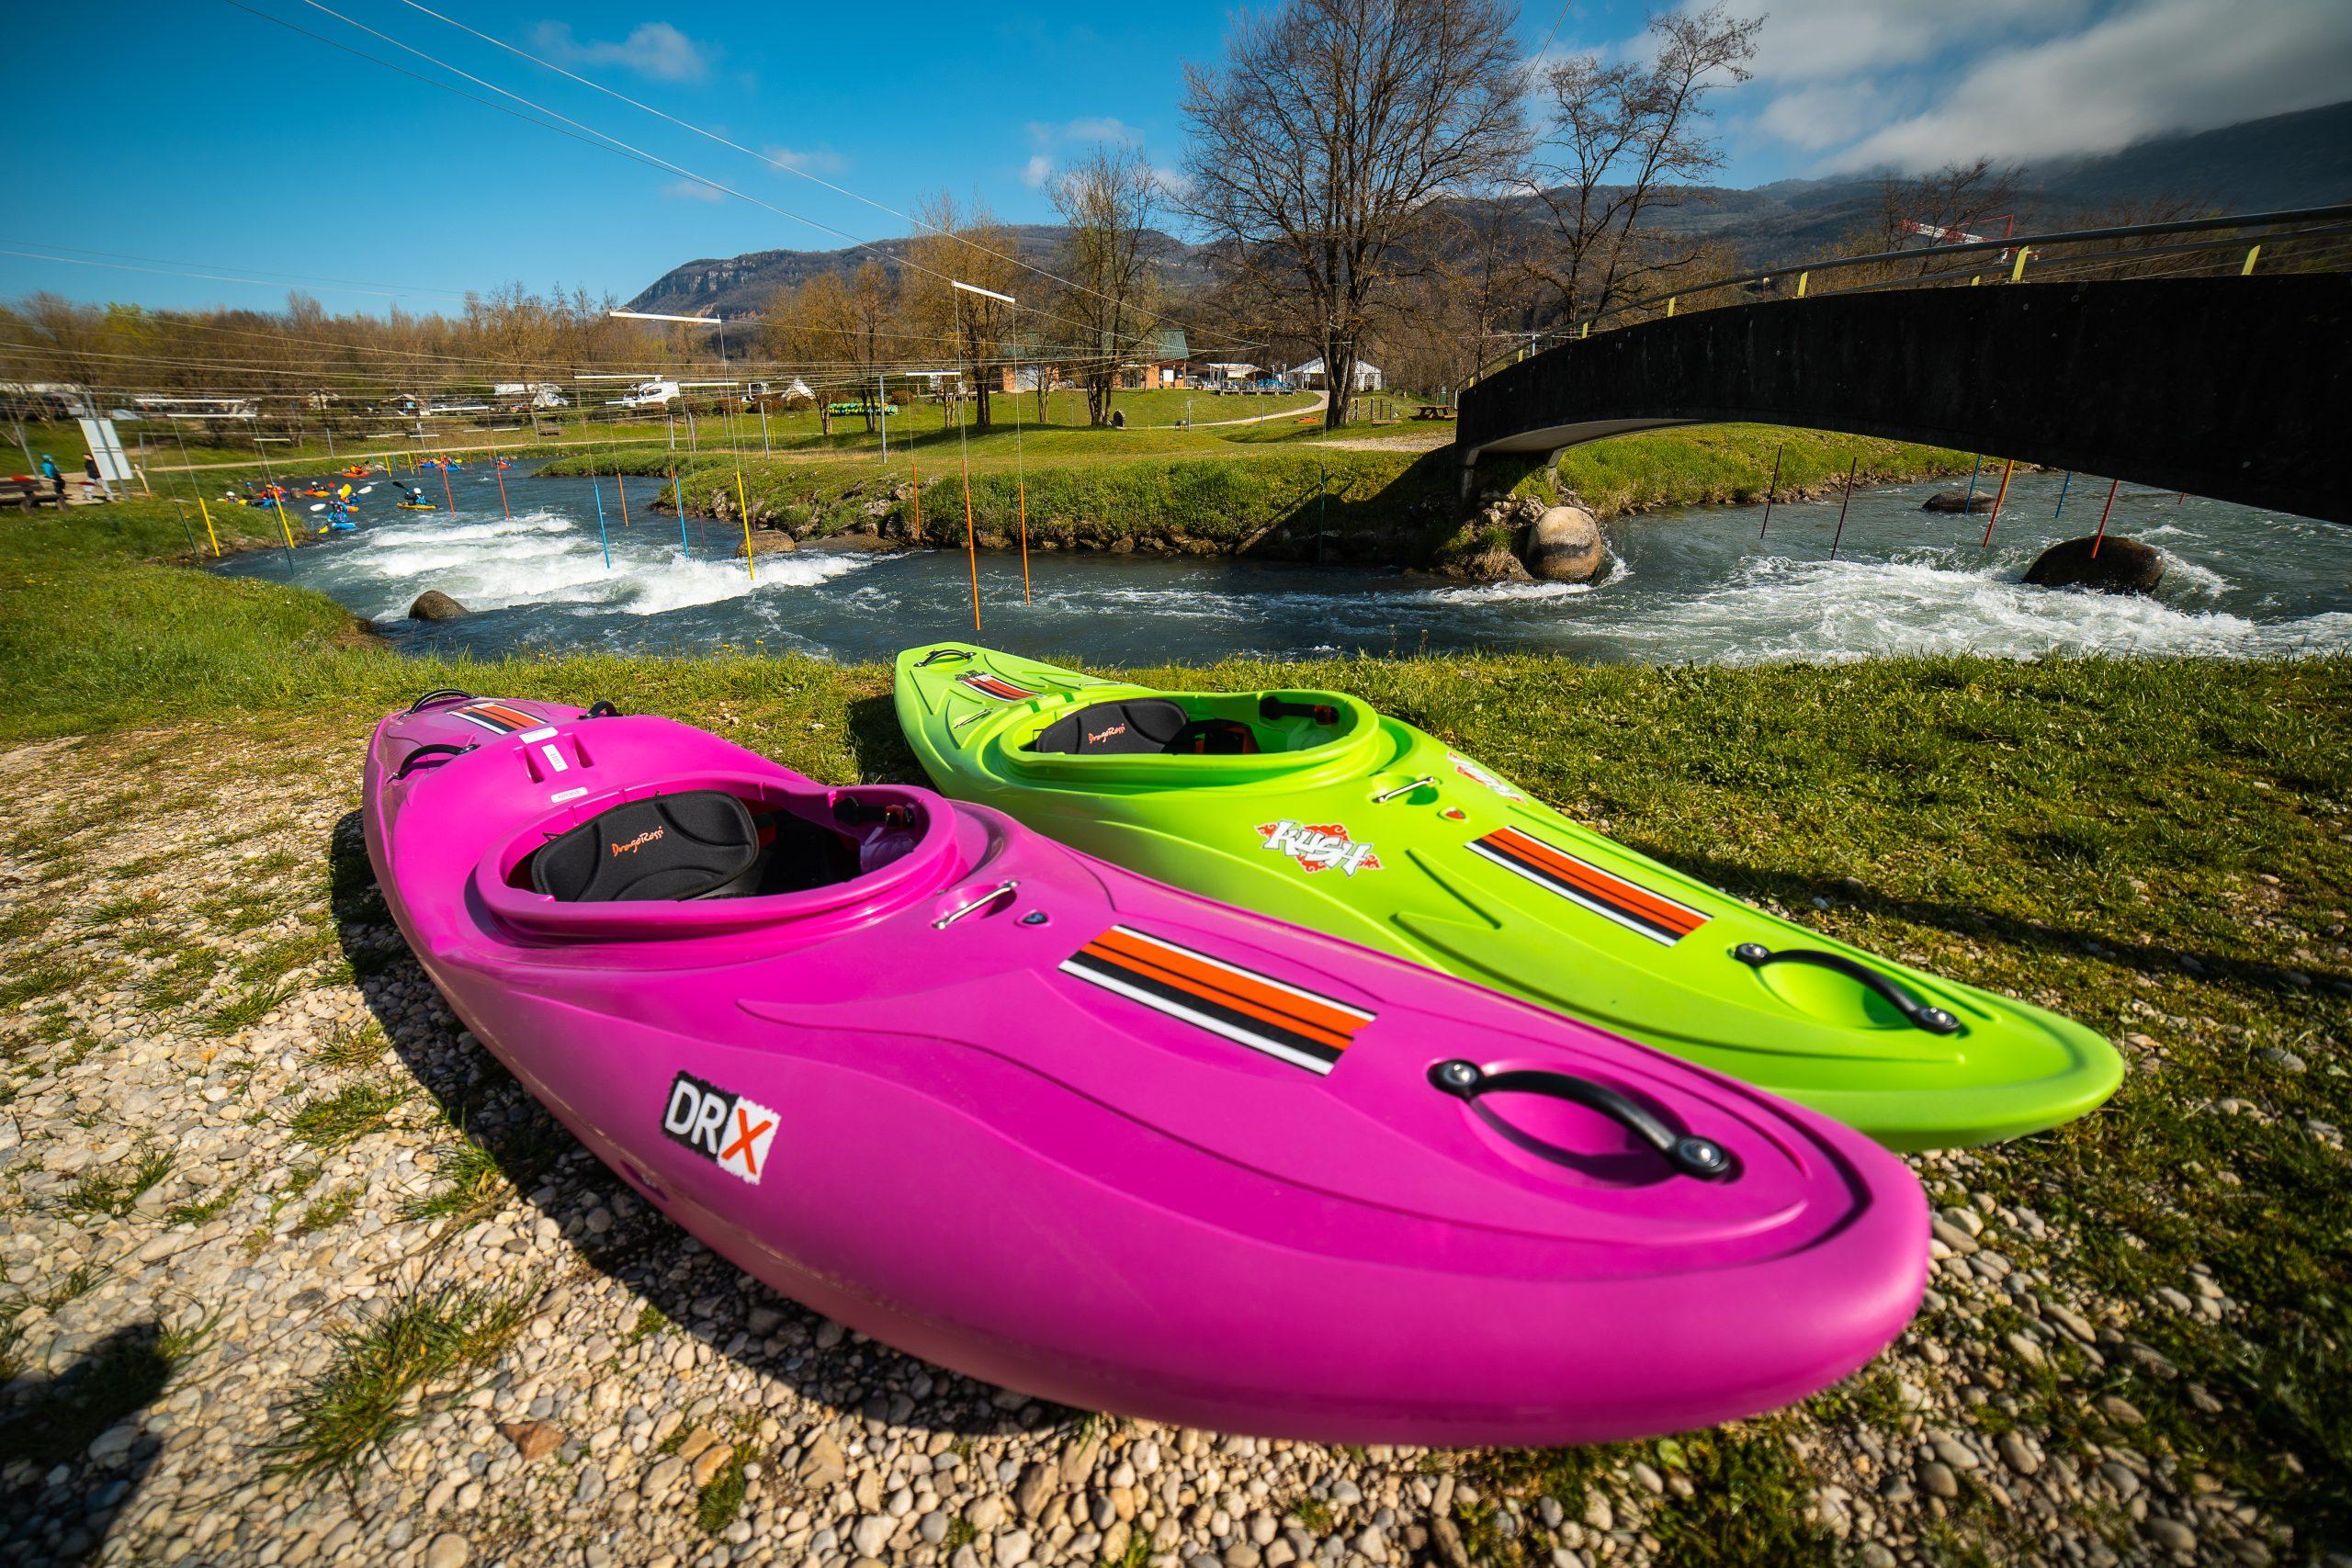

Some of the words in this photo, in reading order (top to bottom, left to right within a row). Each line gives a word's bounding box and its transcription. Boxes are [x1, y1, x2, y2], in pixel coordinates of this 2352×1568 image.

[1088, 724, 1125, 744] DragoRossi
[611, 827, 664, 856] DragoRossi
[665, 1079, 773, 1175] DRX
